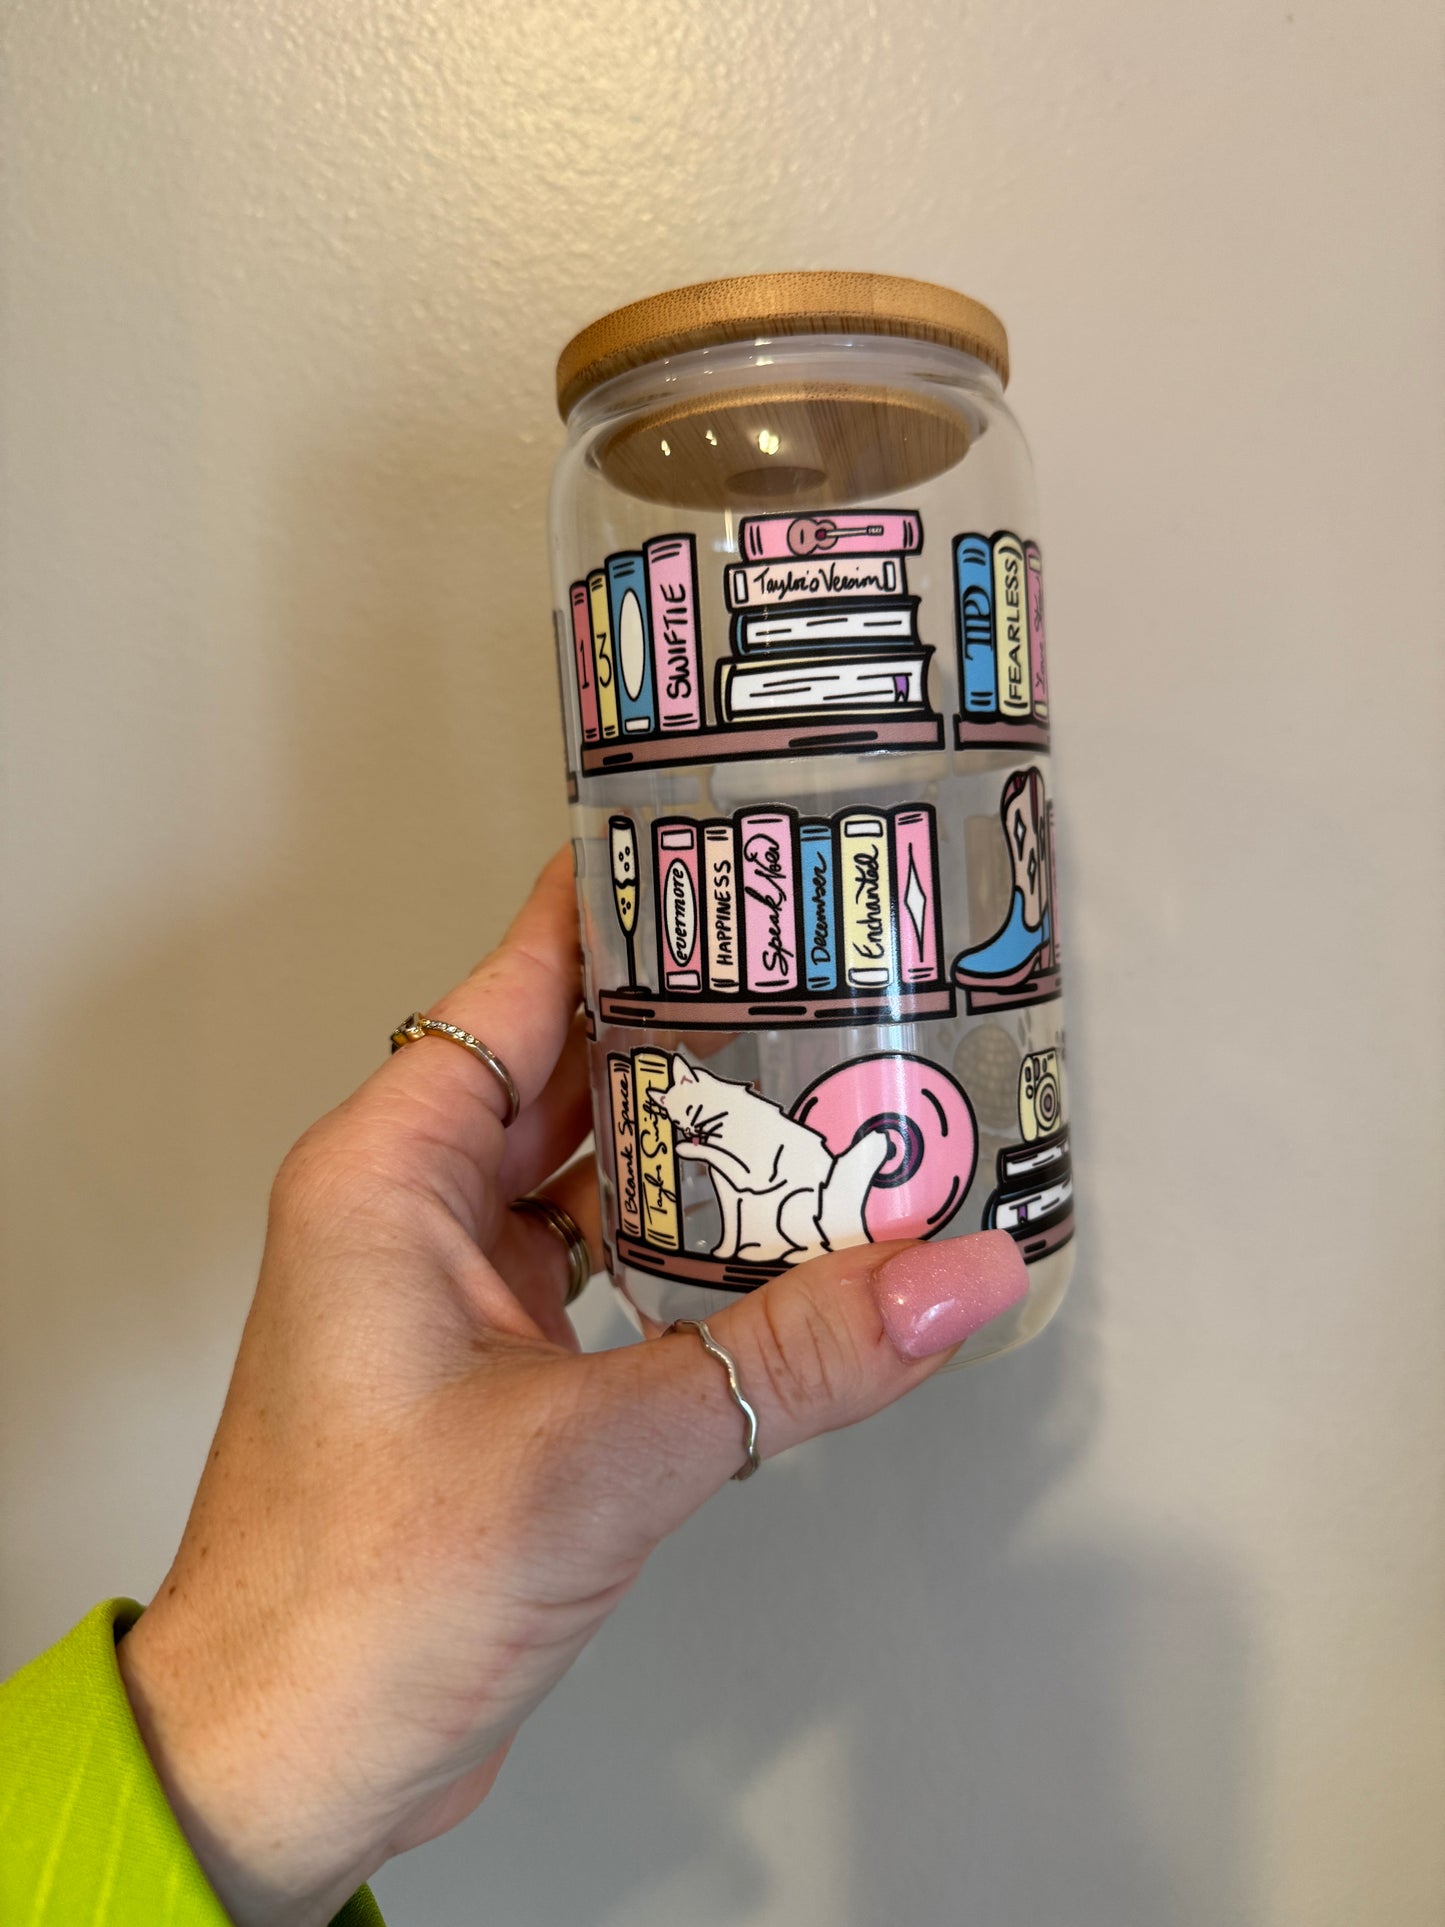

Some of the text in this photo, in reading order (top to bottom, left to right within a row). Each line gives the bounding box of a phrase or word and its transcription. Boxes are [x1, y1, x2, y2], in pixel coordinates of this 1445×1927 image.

[753, 562, 889, 600] Taylor's Version
[1005, 559, 1022, 700] FEARLESS
[660, 583, 692, 699] SWIFTIE
[673, 867, 689, 961] evermore
[716, 859, 734, 965] HAPPINESS
[743, 833, 793, 976] Speak Now
[811, 851, 831, 966] December
[853, 844, 885, 960] Enchanted
[618, 1074, 638, 1214] Blank Space
[642, 1163, 677, 1225] Taylor
